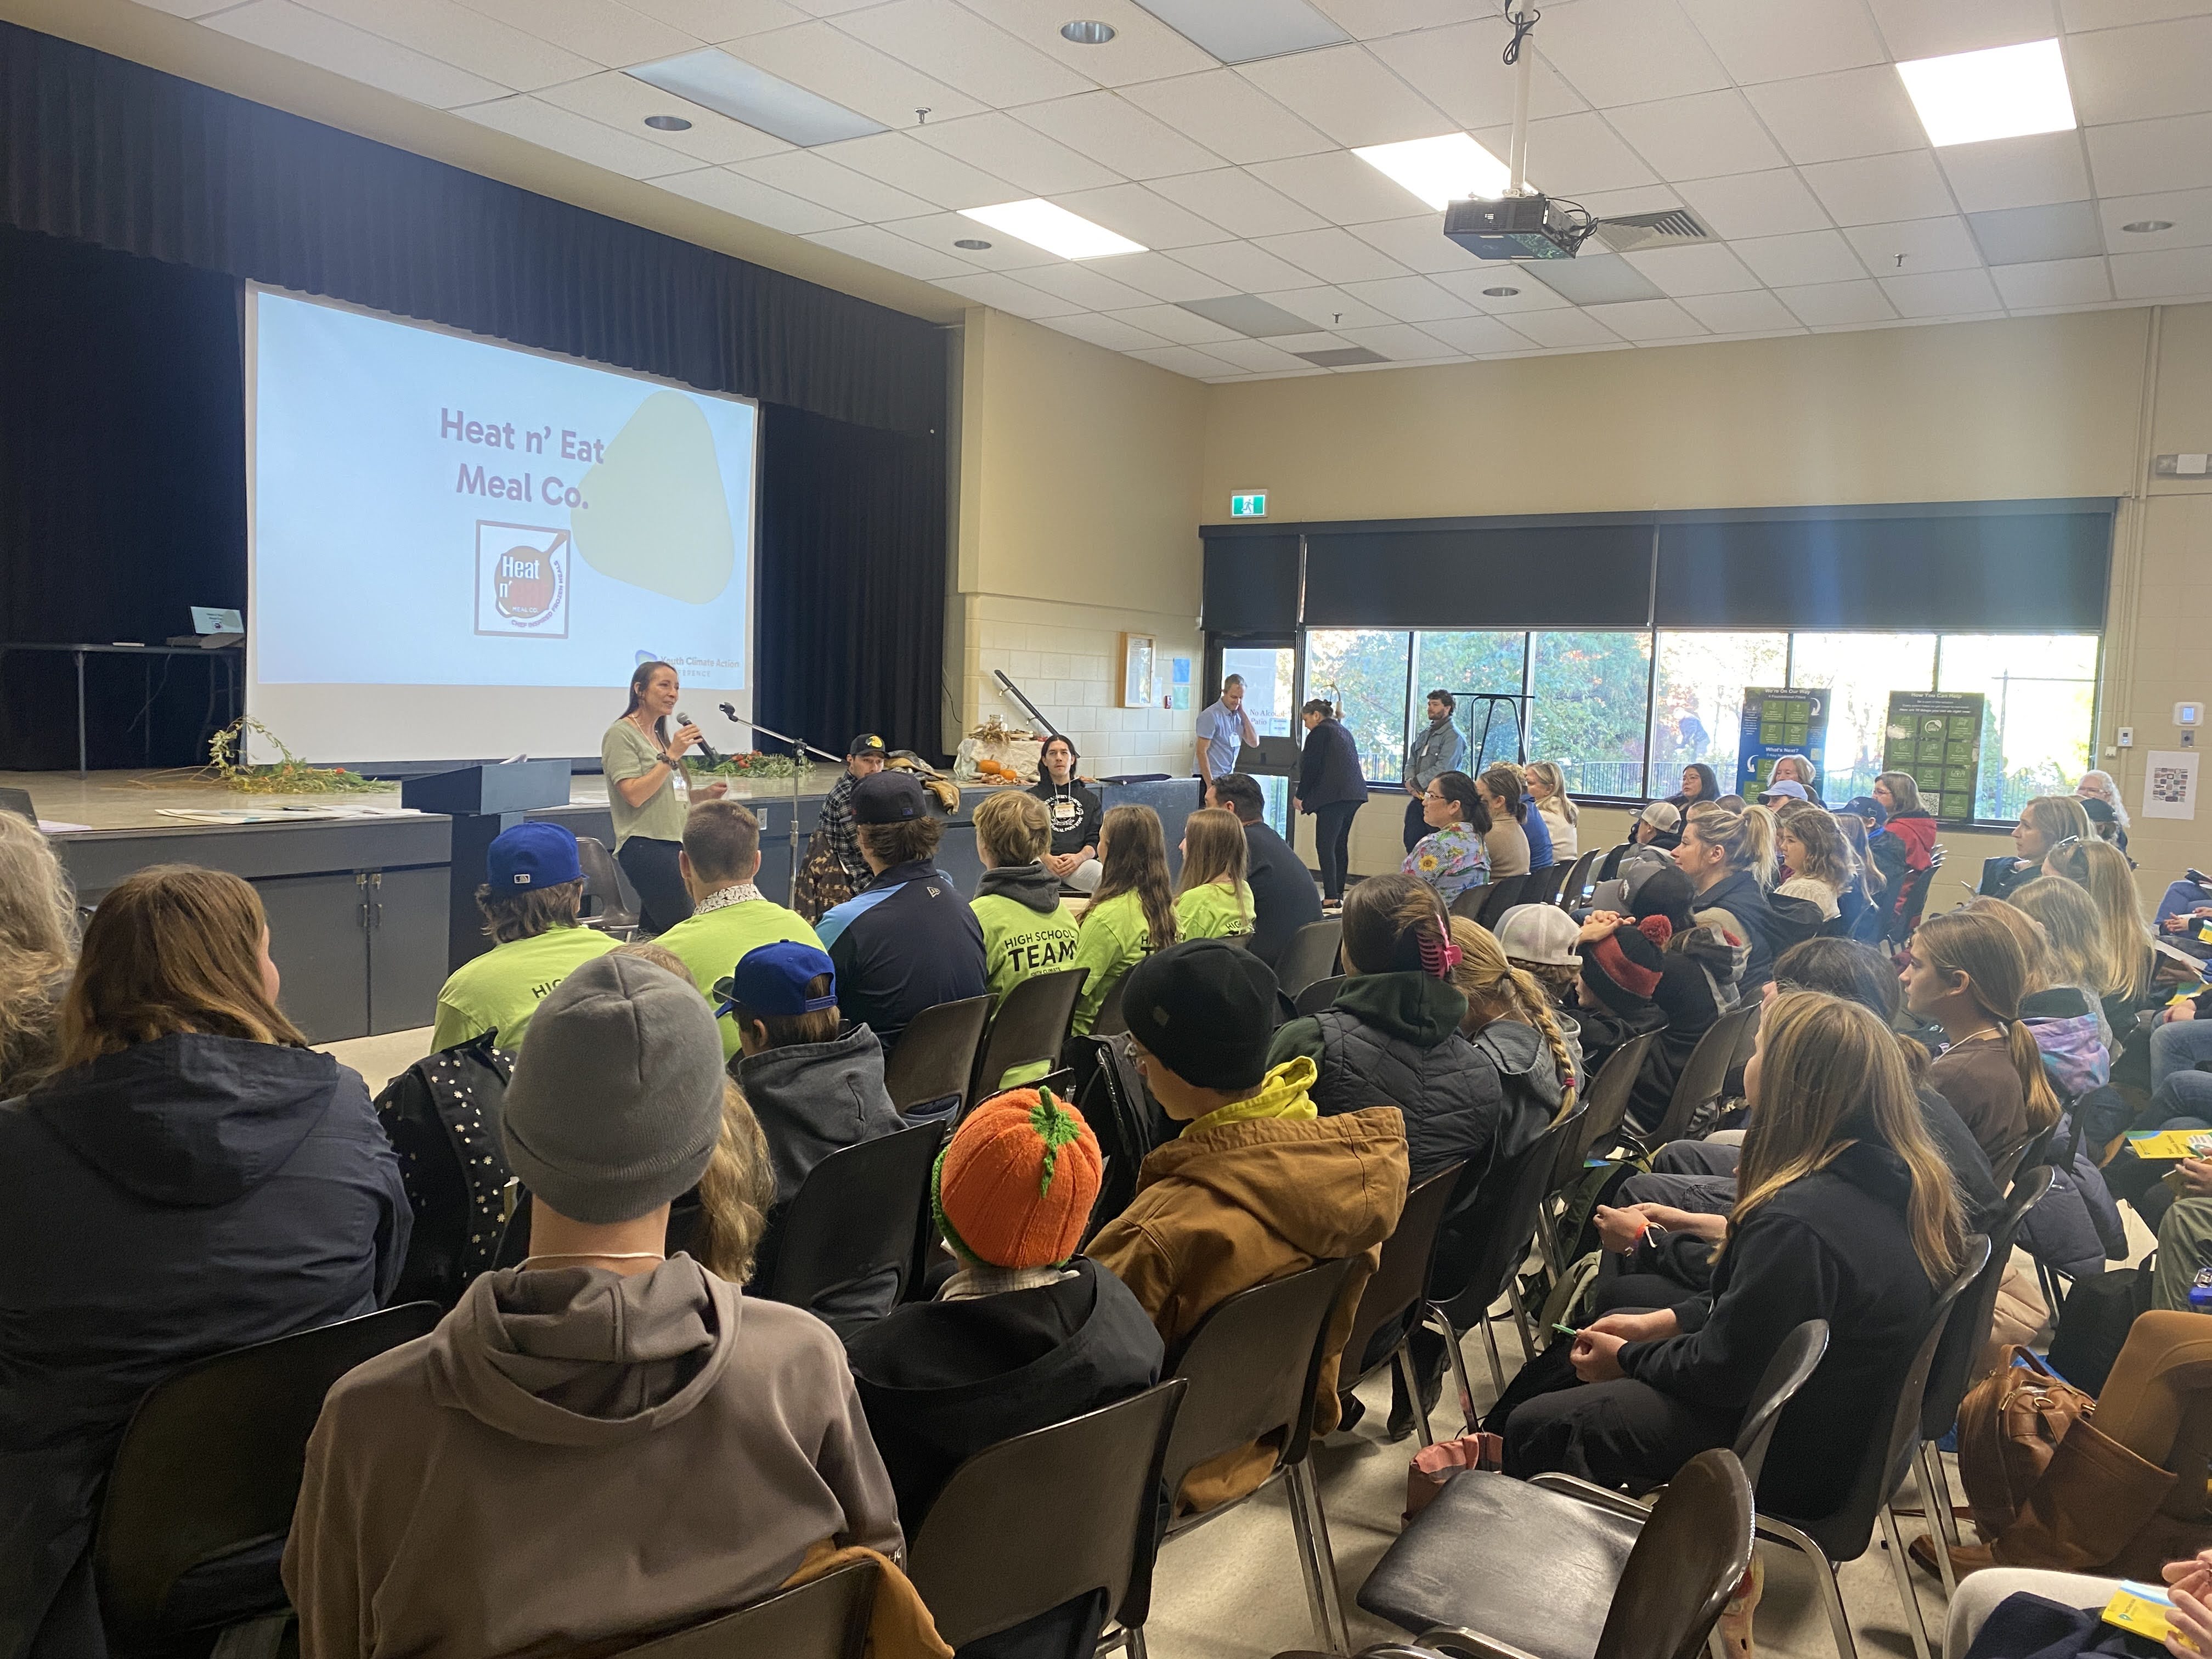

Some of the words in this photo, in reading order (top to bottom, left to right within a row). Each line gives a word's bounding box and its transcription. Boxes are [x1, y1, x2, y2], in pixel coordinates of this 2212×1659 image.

[441, 408, 515, 450] Heat
[561, 429, 604, 464] Eat
[456, 463, 532, 503] Meal
[541, 477, 589, 510] Co.
[503, 556, 540, 579] Heat
[551, 585, 563, 612] FROZEN
[686, 657, 714, 667] Climate
[715, 659, 739, 668] Action
[1005, 933, 1033, 949] HIGH
[1035, 929, 1075, 941] SCHOOL
[1008, 940, 1077, 972] TEAM
